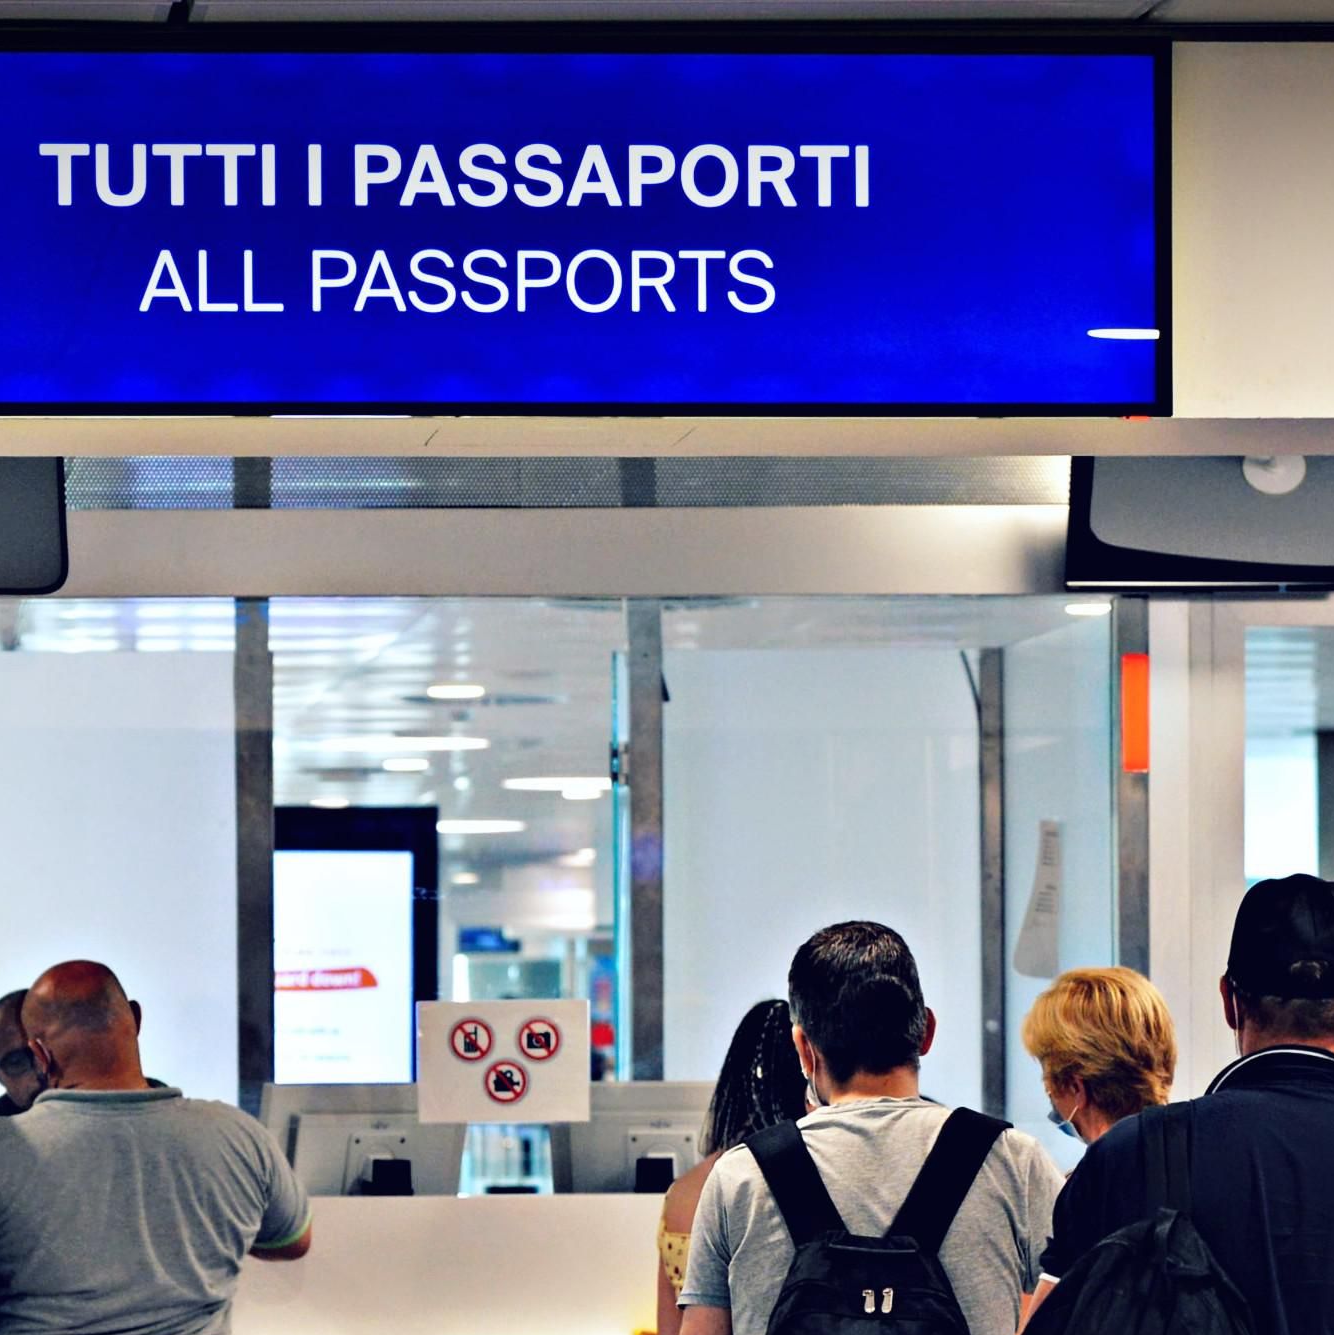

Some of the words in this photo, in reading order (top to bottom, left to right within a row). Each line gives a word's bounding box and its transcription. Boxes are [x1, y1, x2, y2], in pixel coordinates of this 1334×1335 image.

[38, 142, 276, 208] TUTTI
[306, 142, 322, 208] I
[352, 142, 870, 208] PASSAPORTI
[138, 248, 285, 314] ALL
[309, 247, 776, 314] PASSPORTS
